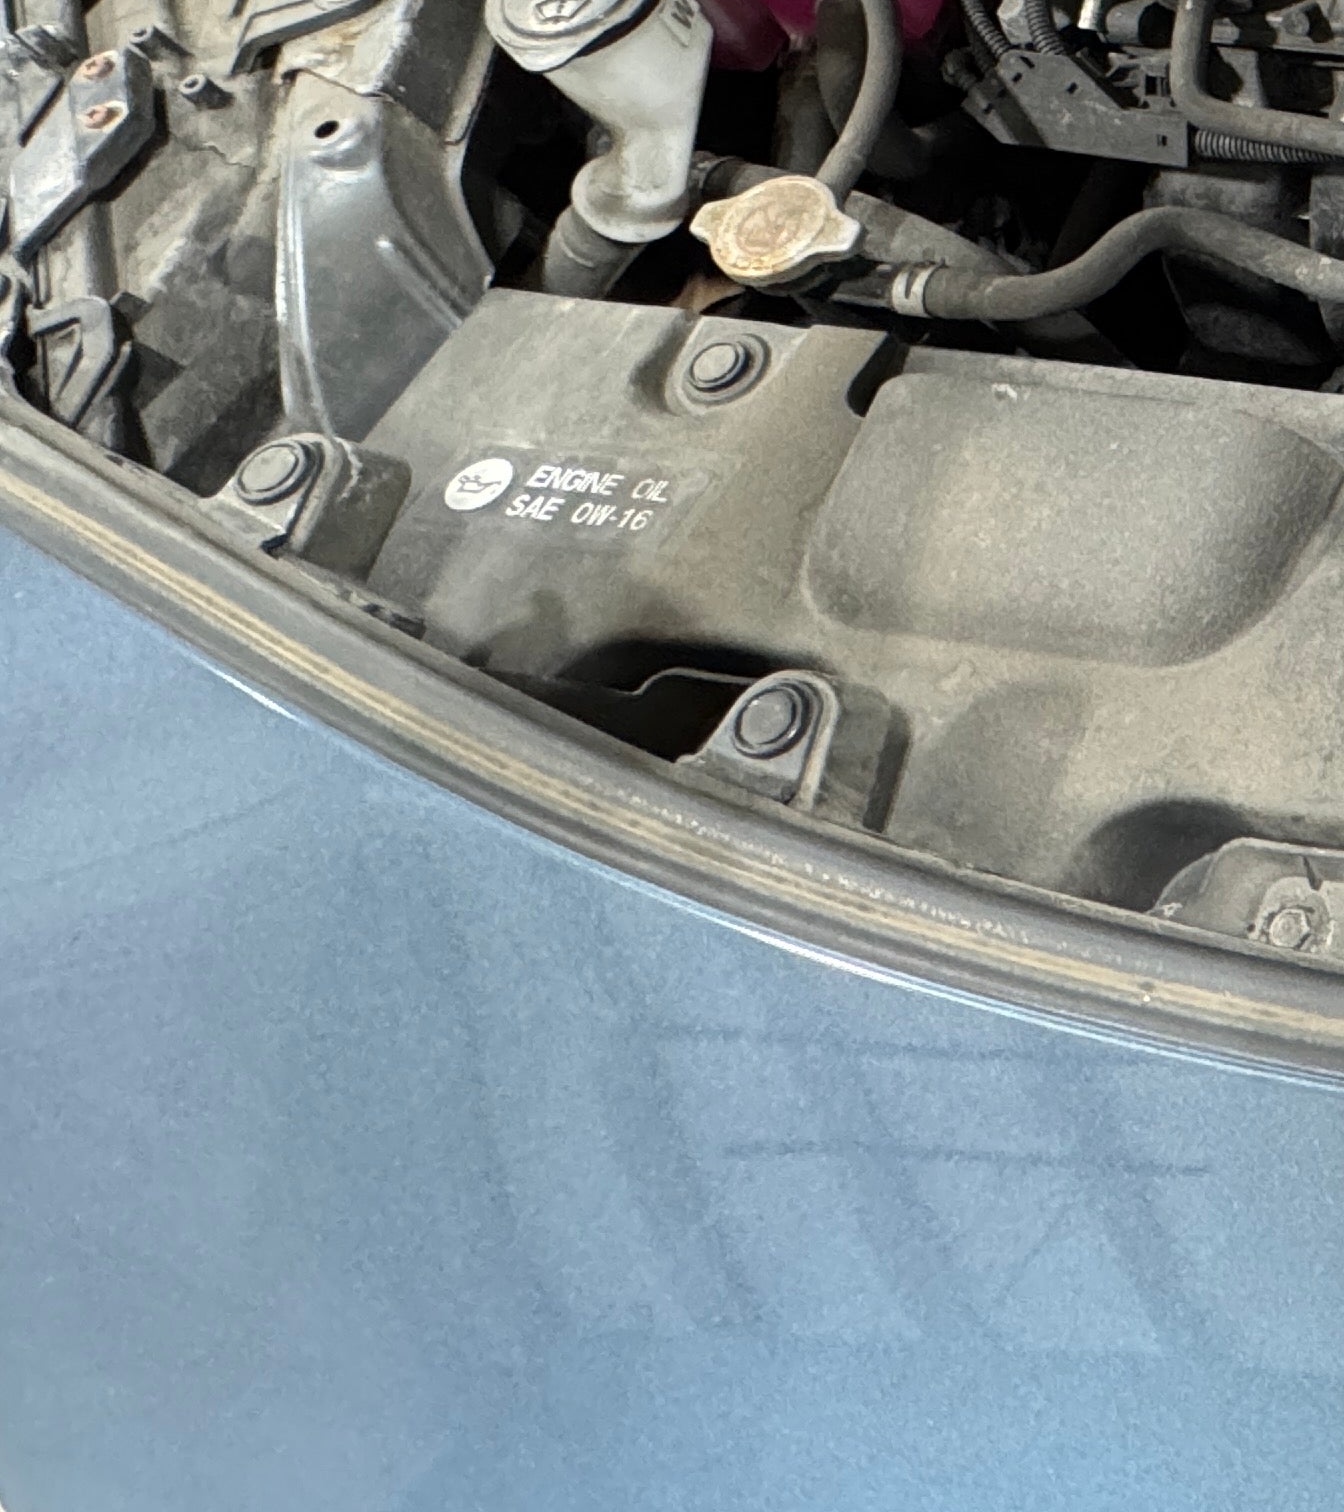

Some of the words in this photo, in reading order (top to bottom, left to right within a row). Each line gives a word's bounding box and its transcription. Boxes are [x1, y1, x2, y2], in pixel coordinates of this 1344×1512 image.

[527, 465, 624, 495] ENGINE
[630, 478, 669, 503] OIL
[505, 494, 566, 522] SAE
[569, 502, 653, 531] 0W-16
